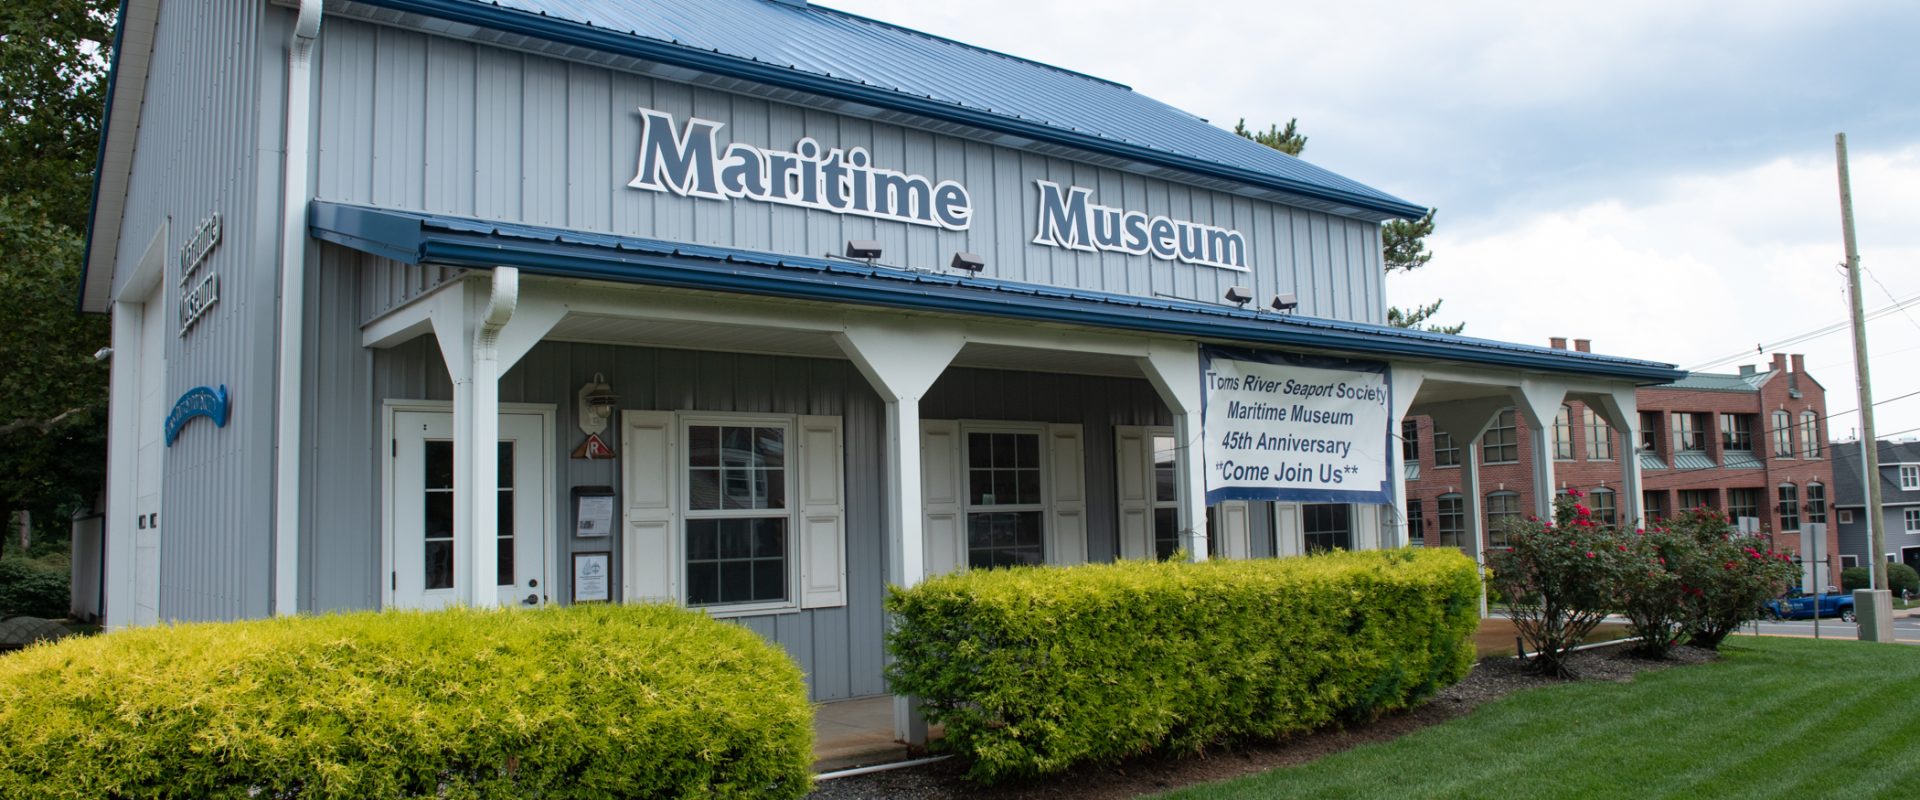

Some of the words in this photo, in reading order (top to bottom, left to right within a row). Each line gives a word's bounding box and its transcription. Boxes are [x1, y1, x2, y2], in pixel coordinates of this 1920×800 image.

[628, 107, 973, 231] Maritime
[1032, 178, 1251, 272] Museum
[179, 212, 220, 288] Maritime
[179, 271, 218, 338] Museum
[1207, 372, 1240, 391] Toms
[1243, 374, 1281, 394] River
[1283, 379, 1334, 399] Seaport
[1336, 382, 1387, 405] Society
[1227, 400, 1287, 421] Maritime
[1291, 404, 1353, 425] Museum
[1222, 431, 1253, 450] 45th
[1256, 431, 1352, 459] Anniversary
[1274, 461, 1313, 482] Join
